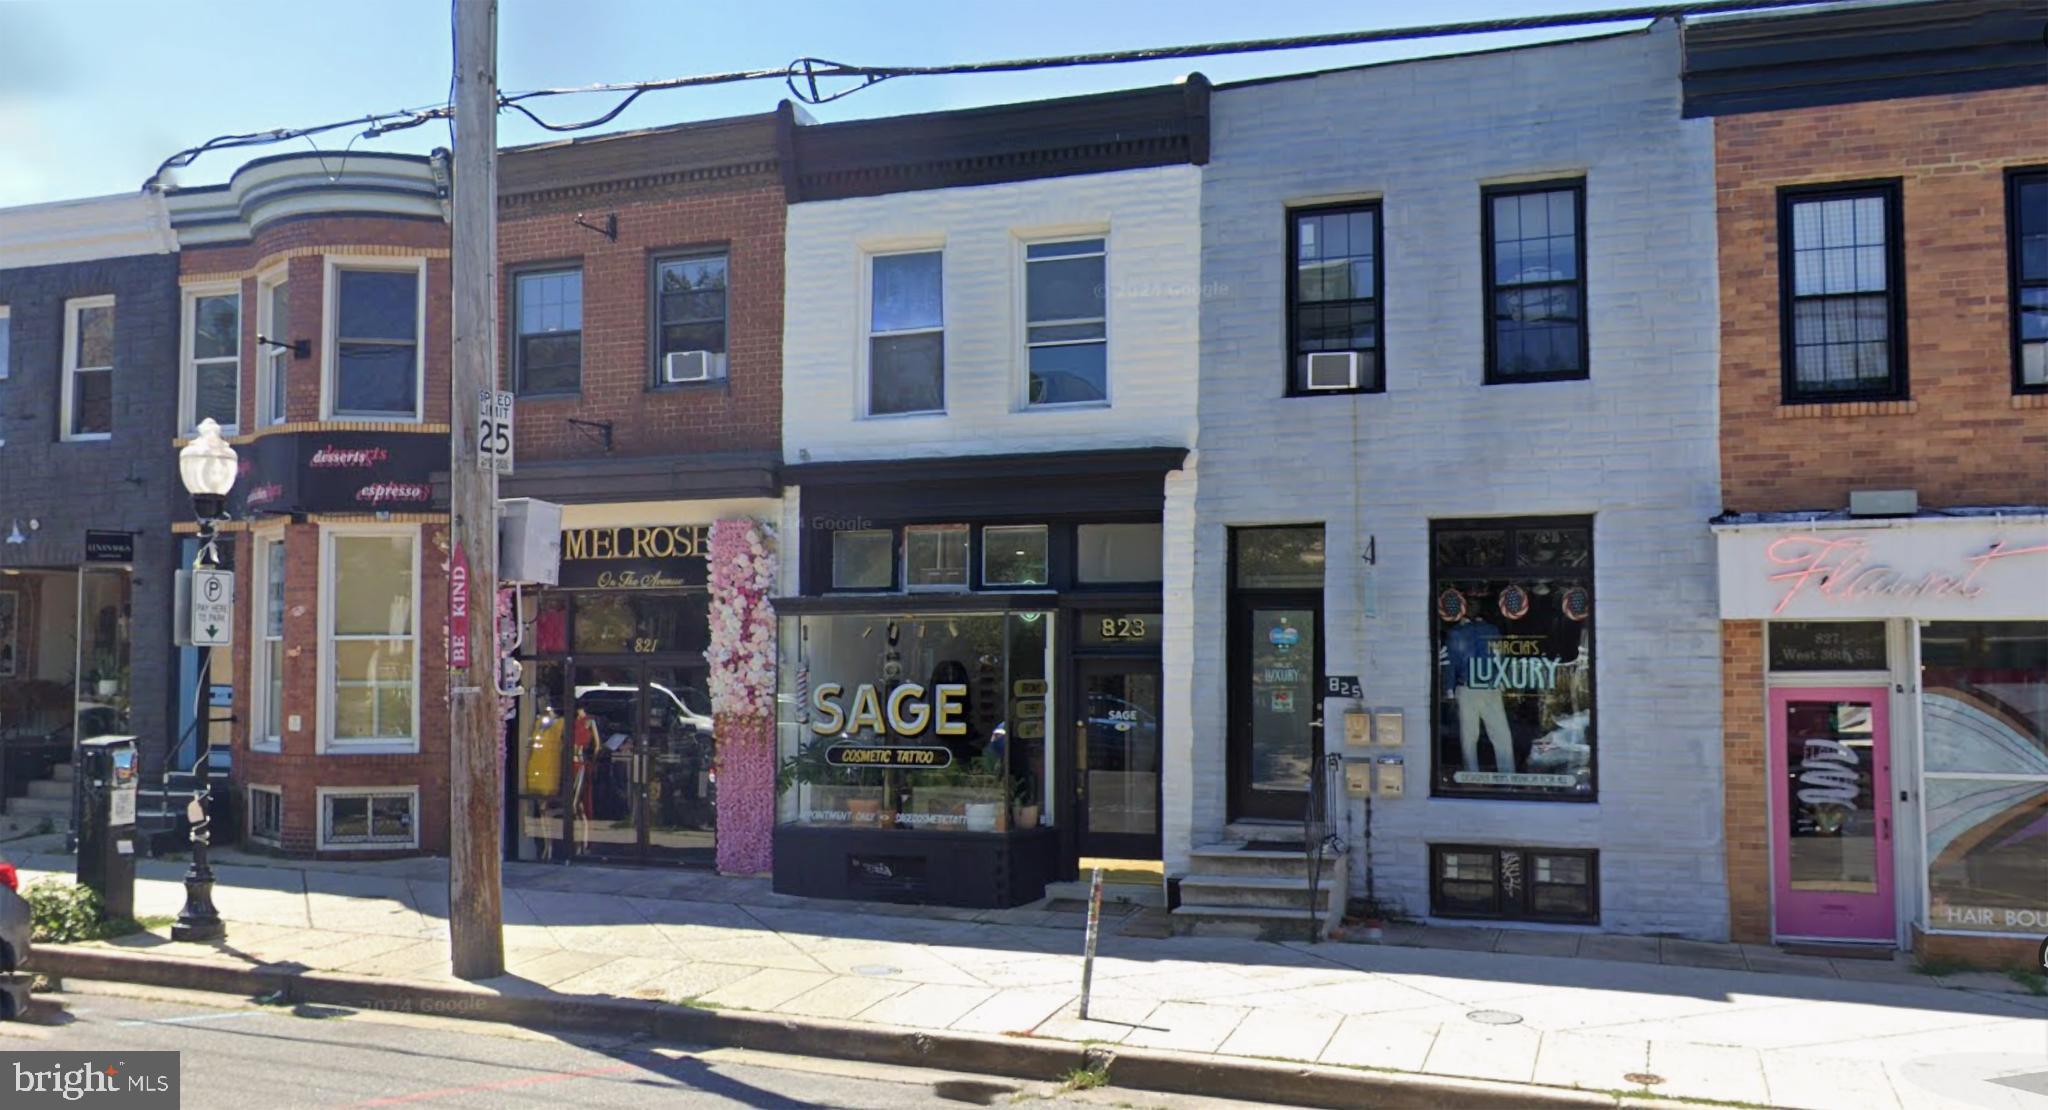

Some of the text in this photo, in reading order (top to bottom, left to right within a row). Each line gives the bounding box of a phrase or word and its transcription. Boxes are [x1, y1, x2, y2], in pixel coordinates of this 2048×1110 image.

[480, 390, 511, 406] SPED
[480, 420, 510, 455] 25
[311, 447, 369, 466] desserts
[359, 483, 425, 504] espresso
[453, 566, 466, 661] BE KIND
[1102, 619, 1145, 637] 823
[634, 637, 658, 652] 821
[1265, 668, 1299, 682] LUXURY
[1468, 656, 1562, 689] LUXURY
[1329, 677, 1361, 697] 825
[811, 683, 968, 738] SAGE
[1108, 710, 1137, 721] SAGE
[841, 749, 935, 765] COSMETIC TATTOO
[1948, 907, 1994, 925] HAIR
